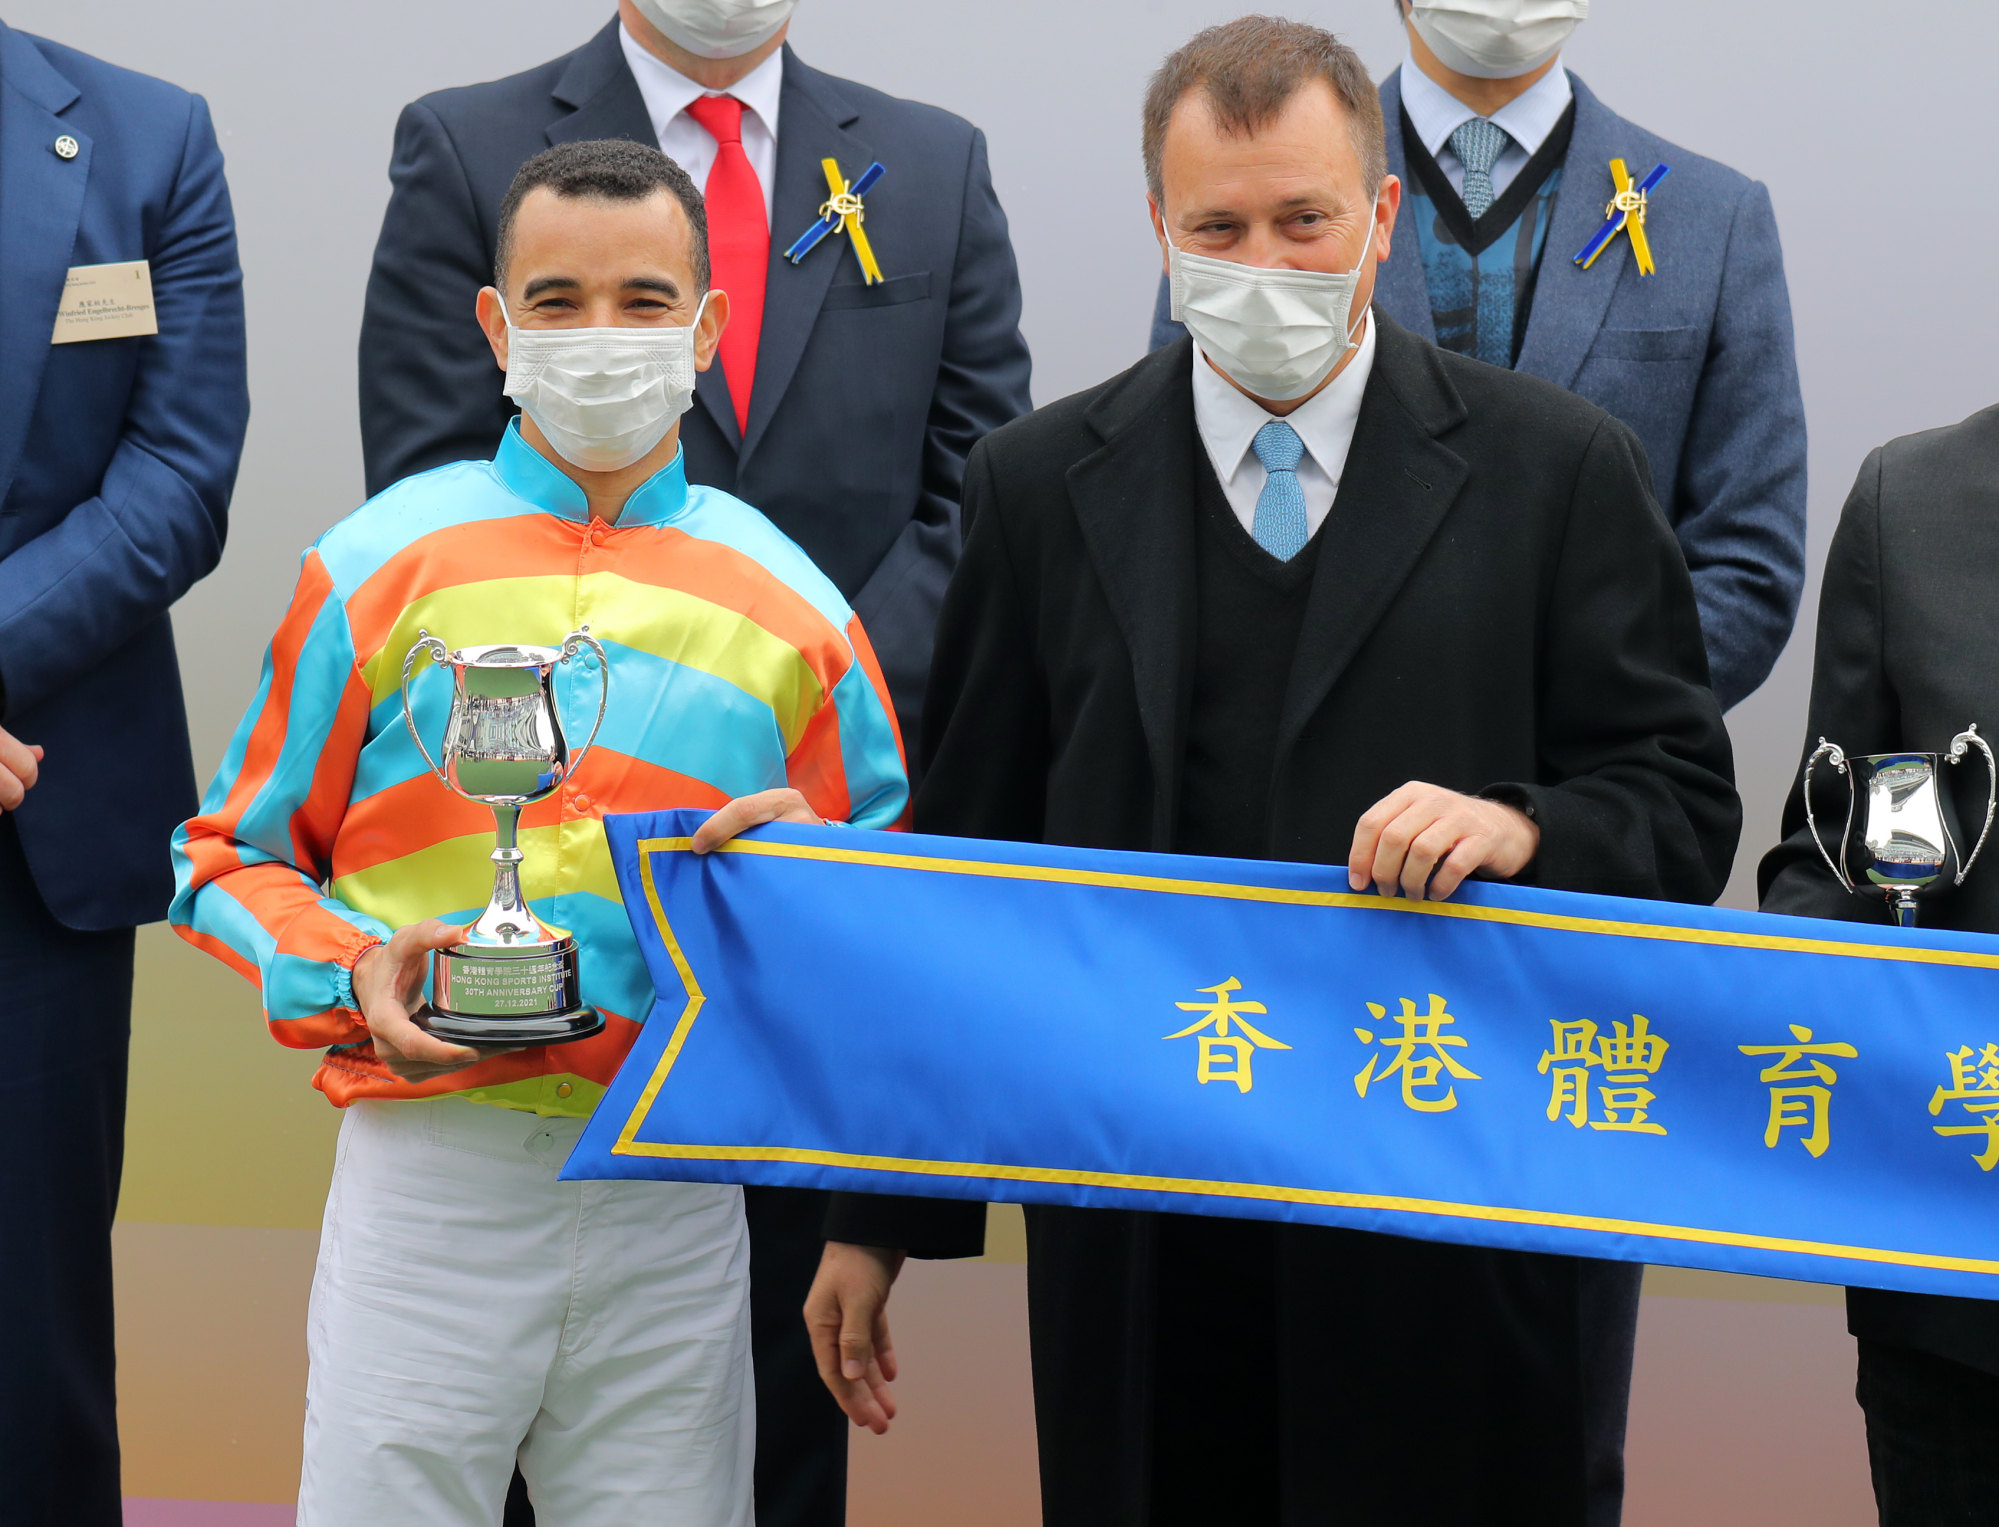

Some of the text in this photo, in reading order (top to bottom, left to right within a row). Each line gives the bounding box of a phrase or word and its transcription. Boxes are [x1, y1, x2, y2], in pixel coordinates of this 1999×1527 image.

[451, 968, 572, 986] HONG KONG SPORTS INSTITUTE
[464, 982, 565, 997] 30TH ANNIVERSARY CUP
[494, 998, 538, 1009] 27.12.2021
